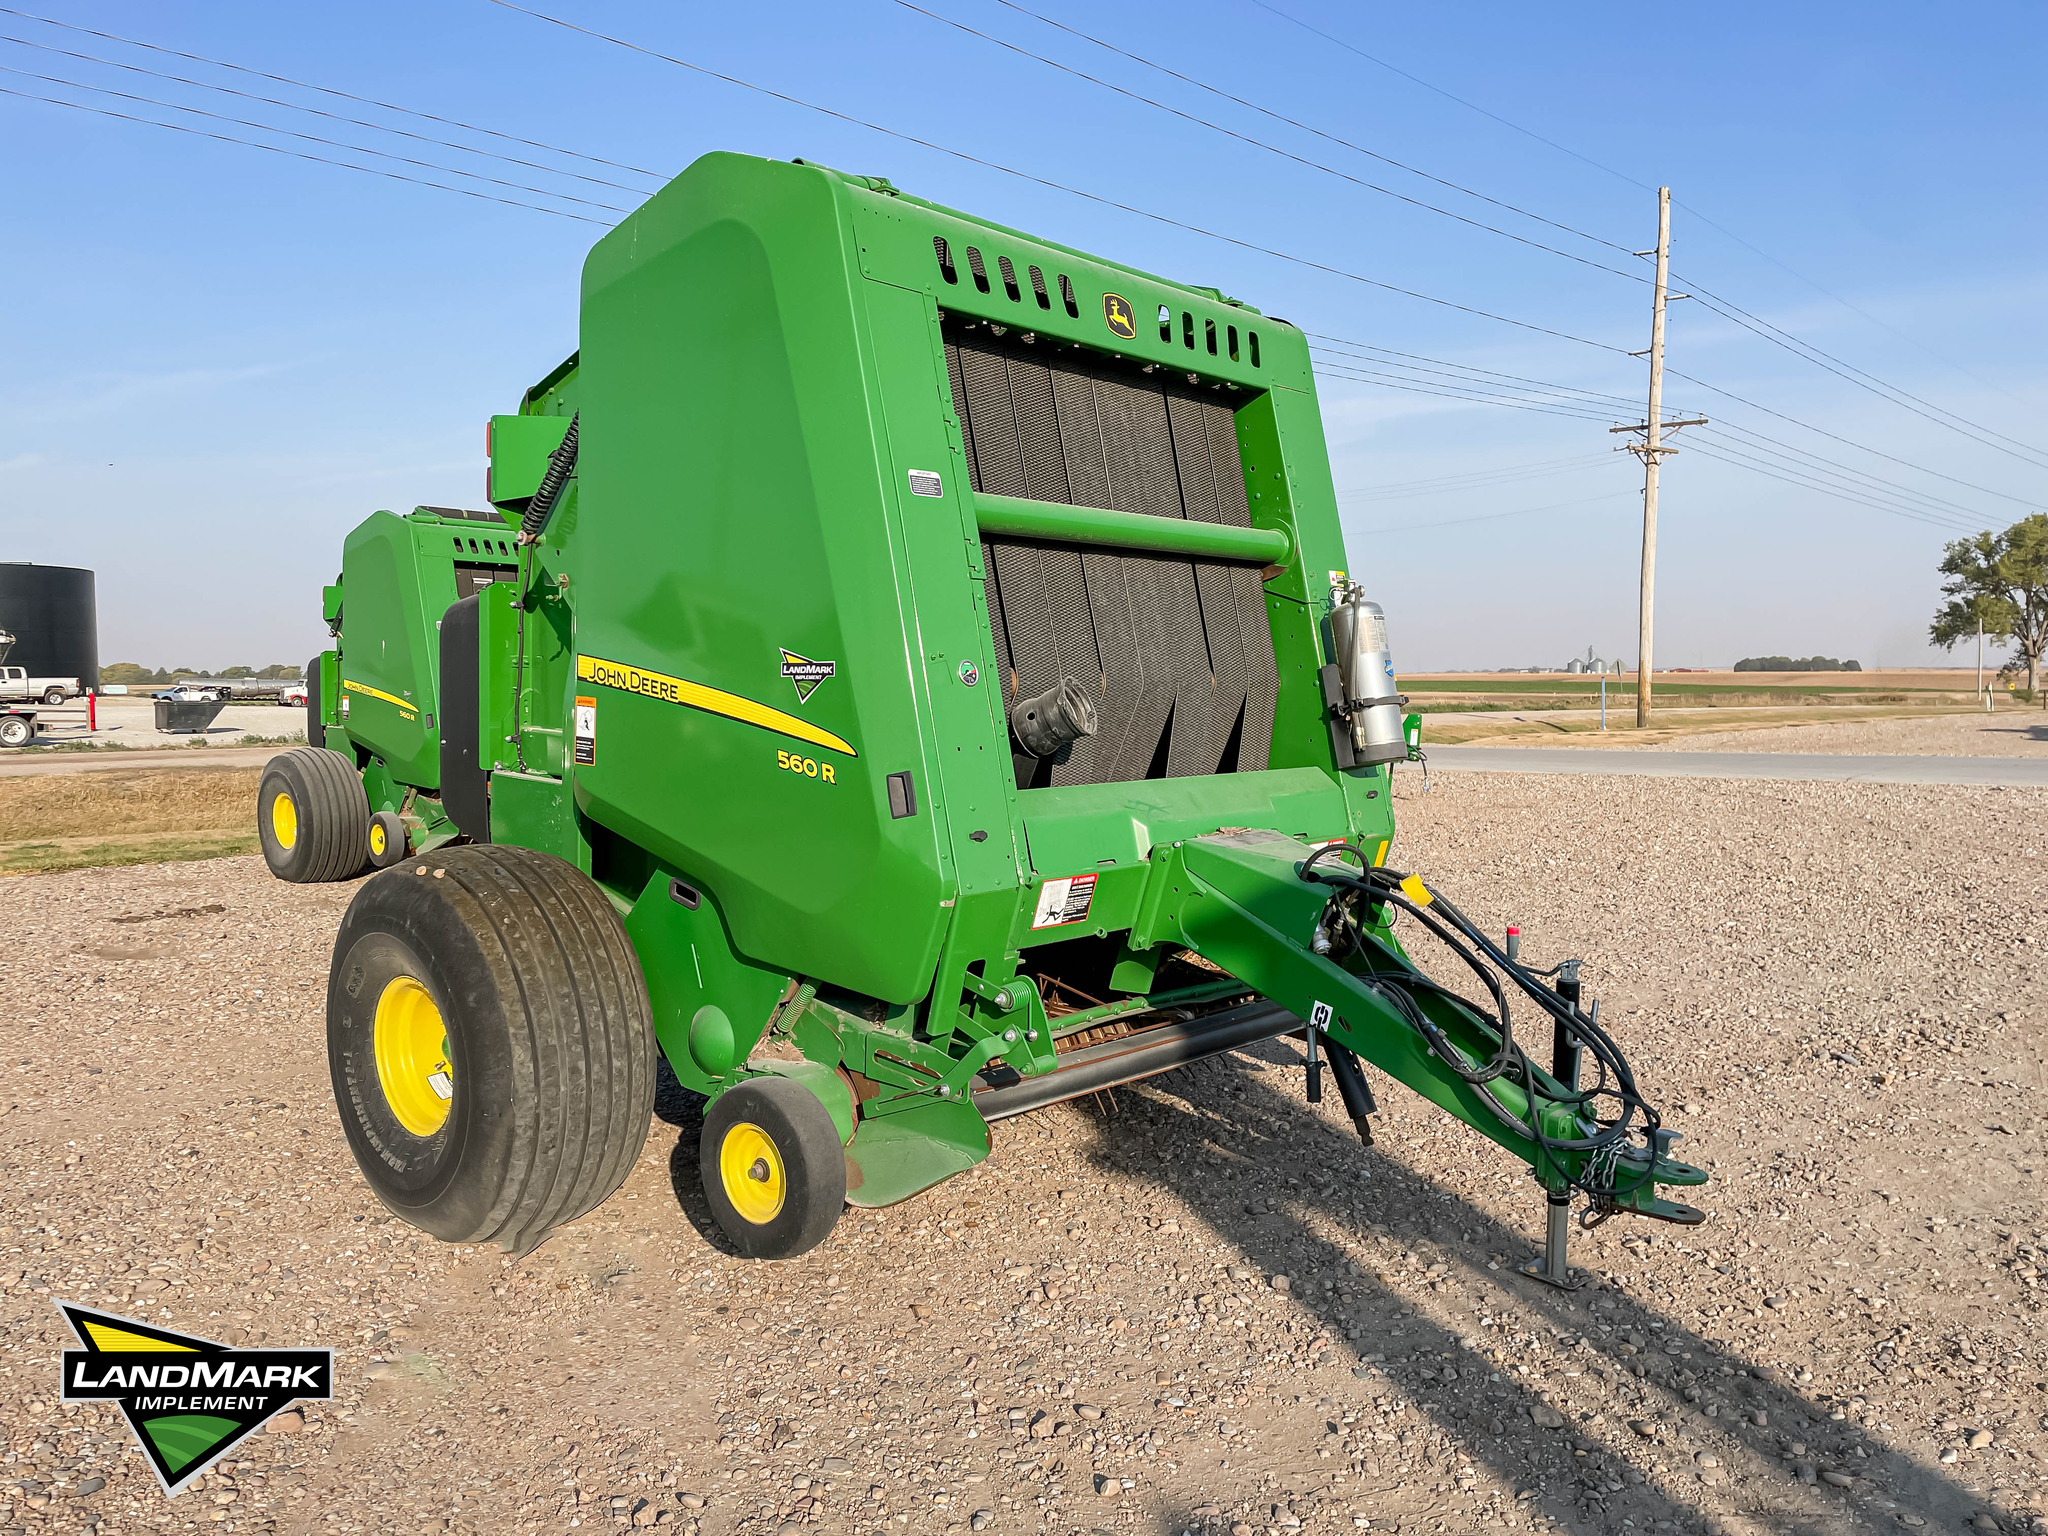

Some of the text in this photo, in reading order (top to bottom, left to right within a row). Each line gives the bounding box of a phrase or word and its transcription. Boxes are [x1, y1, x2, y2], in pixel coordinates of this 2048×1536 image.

[589, 662, 678, 700] JOHN DEERE
[783, 665, 833, 674] LANDMARK
[399, 710, 411, 720] 560
[777, 749, 837, 786] 560 R
